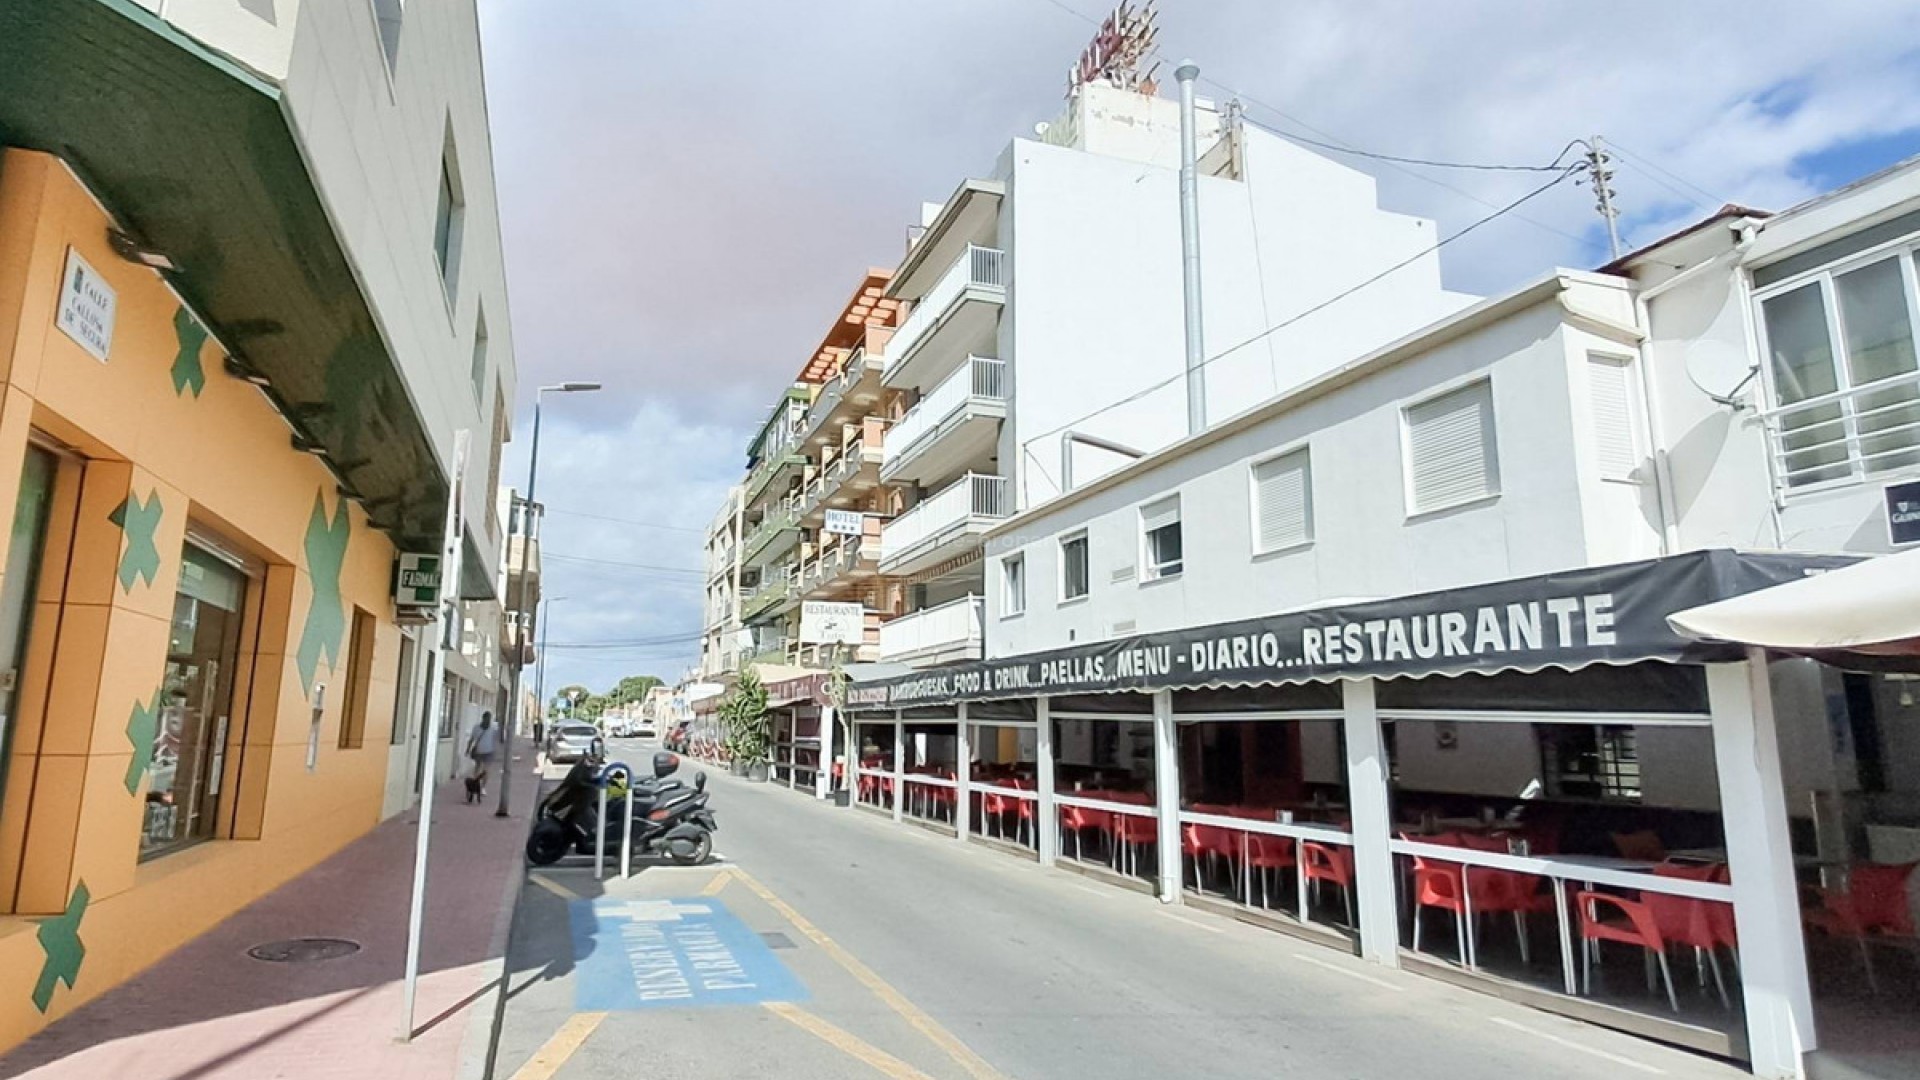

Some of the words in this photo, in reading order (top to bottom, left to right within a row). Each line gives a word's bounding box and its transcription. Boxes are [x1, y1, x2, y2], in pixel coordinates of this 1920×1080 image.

[85, 281, 107, 309] CALLE
[826, 511, 860, 524] HOTEL
[402, 571, 441, 587] FARMAC
[804, 604, 861, 617] RESTAURANTE
[984, 669, 992, 691] &
[1117, 646, 1170, 678] MENU
[1303, 593, 1616, 666] RESTAURANTE
